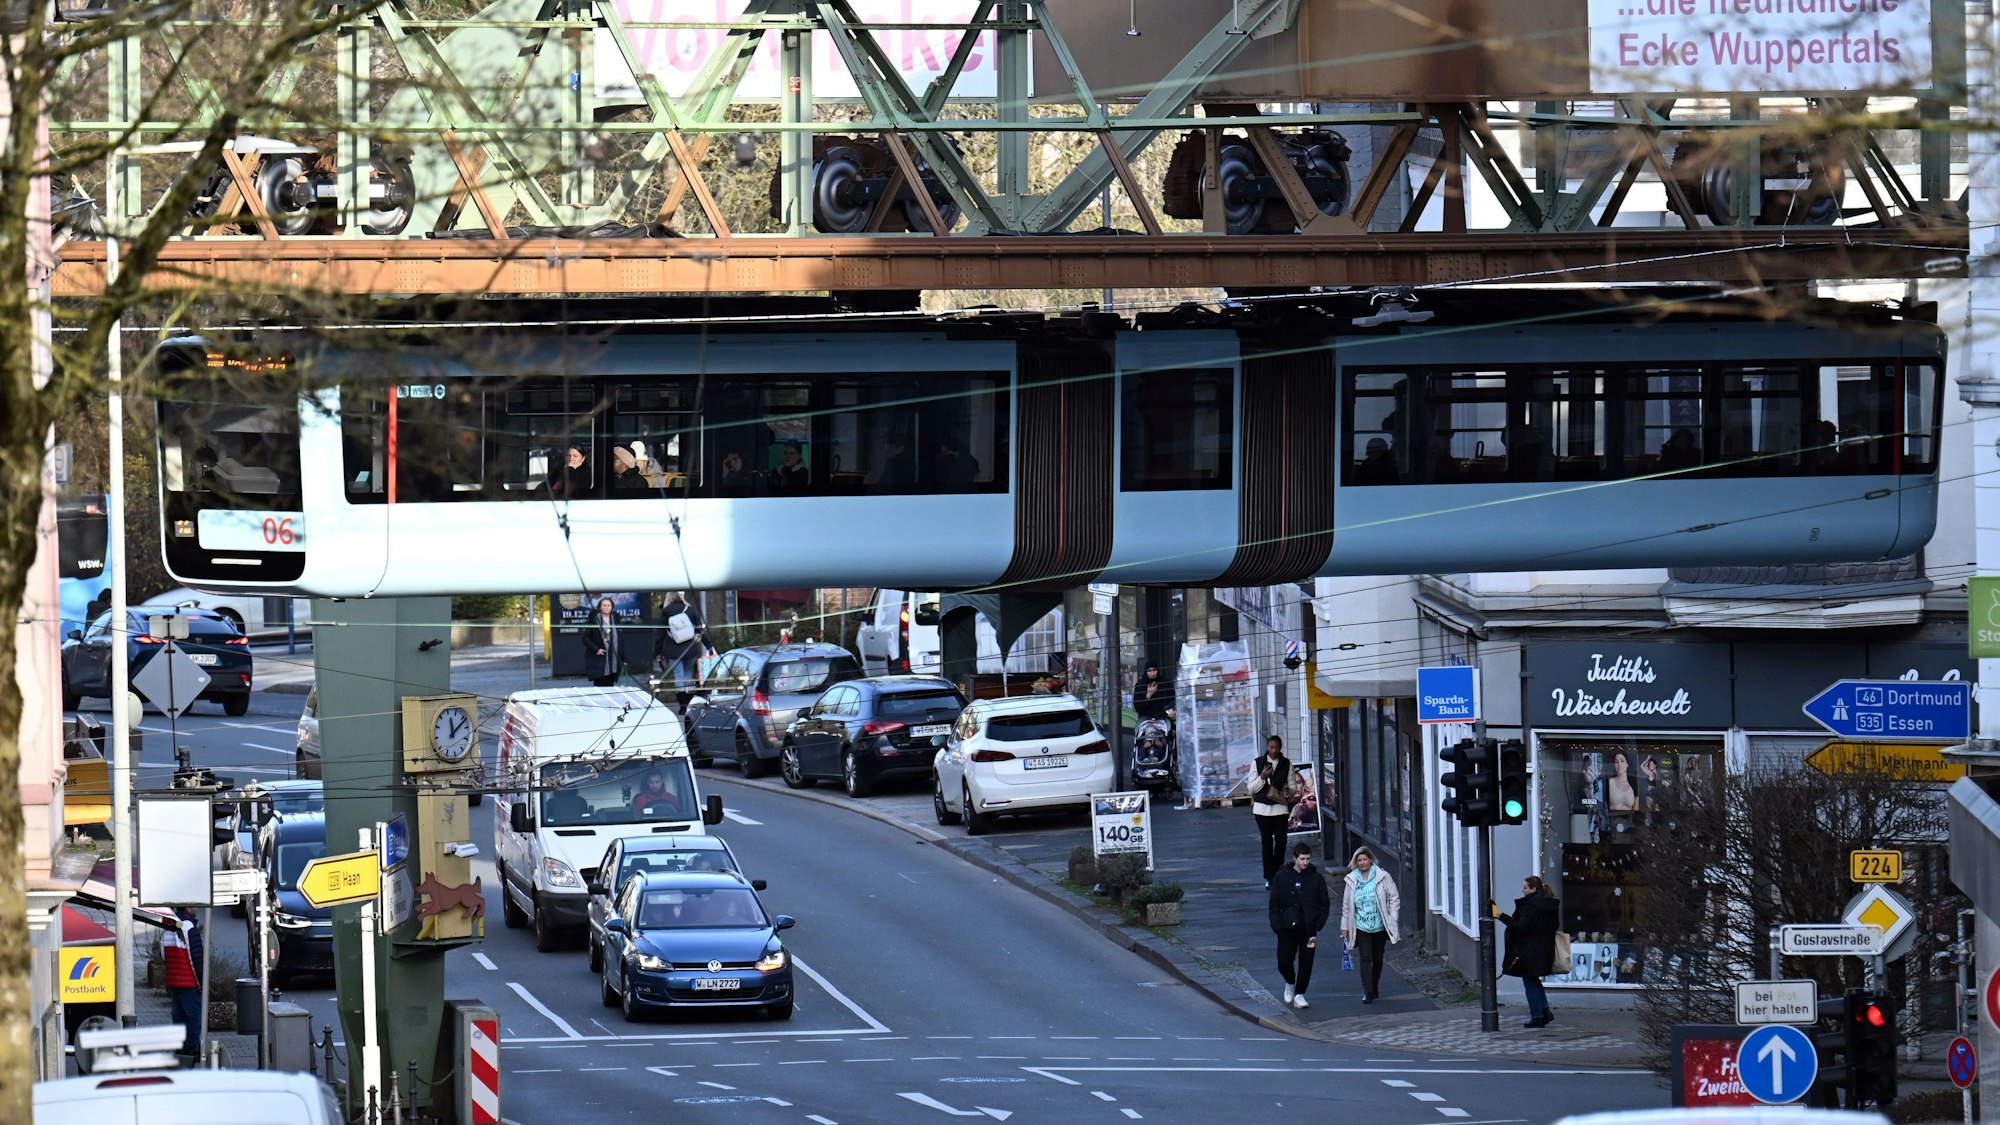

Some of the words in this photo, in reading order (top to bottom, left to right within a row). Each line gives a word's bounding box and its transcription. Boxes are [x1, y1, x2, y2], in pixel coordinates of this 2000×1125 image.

[1619, 32, 1699, 66] Ecke
[1709, 30, 1901, 73] Wuppertals
[263, 518, 294, 545] 06
[1587, 653, 1657, 683] Judith's
[1424, 695, 1469, 707] Sparda-
[1552, 688, 1691, 716] Wäschewelt
[1863, 691, 1876, 703] 46
[1888, 690, 1962, 706] Dortmund
[1438, 705, 1469, 715] Bank
[1860, 716, 1880, 728] 535
[1888, 715, 1934, 730] Essen
[1882, 755, 1948, 770] Mettmann
[1099, 825, 1130, 843] 140
[1130, 835, 1144, 843] GB
[1861, 857, 1891, 876] 224
[330, 875, 340, 887] 228
[343, 871, 361, 887] Haan
[1794, 933, 1871, 946] Gustavstraße
[65, 985, 106, 994] Postbank
[695, 980, 702, 988] W
[706, 979, 718, 988] LN
[719, 979, 739, 988] 2727
[1755, 991, 1773, 1001] bei
[1777, 989, 1797, 1000] Rot
[1744, 1005, 1767, 1015] hier
[1773, 1004, 1809, 1014] halten
